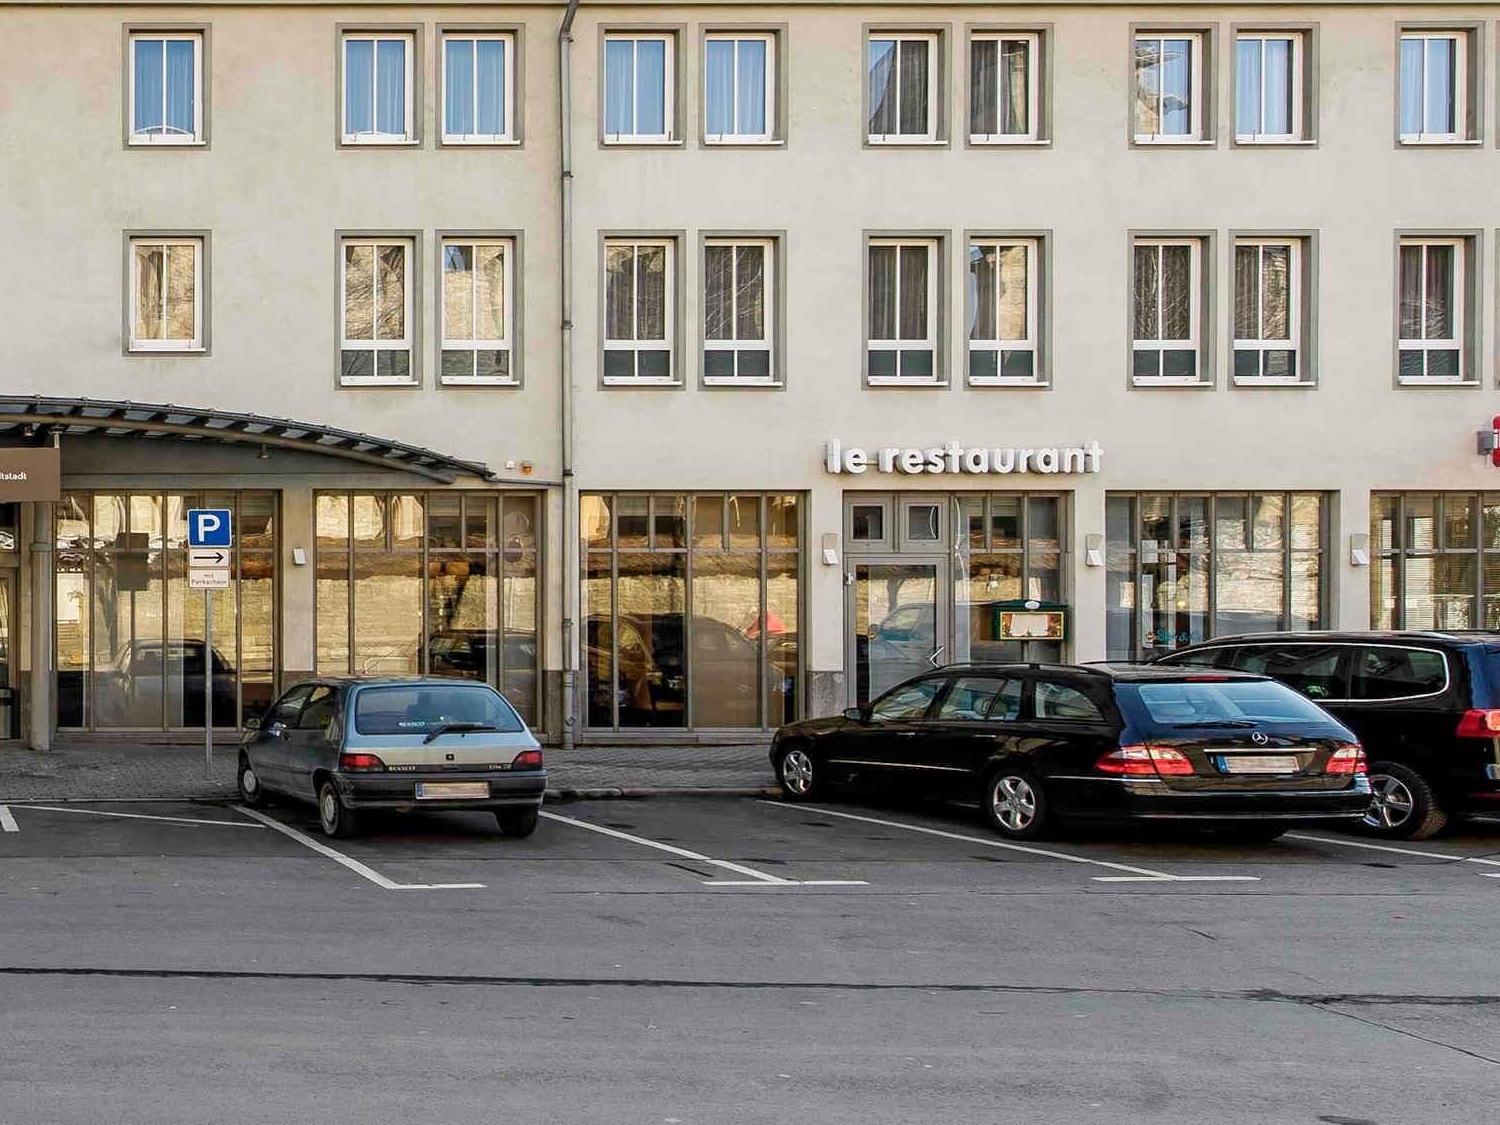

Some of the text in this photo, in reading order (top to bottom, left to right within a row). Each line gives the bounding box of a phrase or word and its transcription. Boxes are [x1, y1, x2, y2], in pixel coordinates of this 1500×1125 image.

[826, 438, 1104, 474] le restaurant
[198, 514, 220, 542] P
